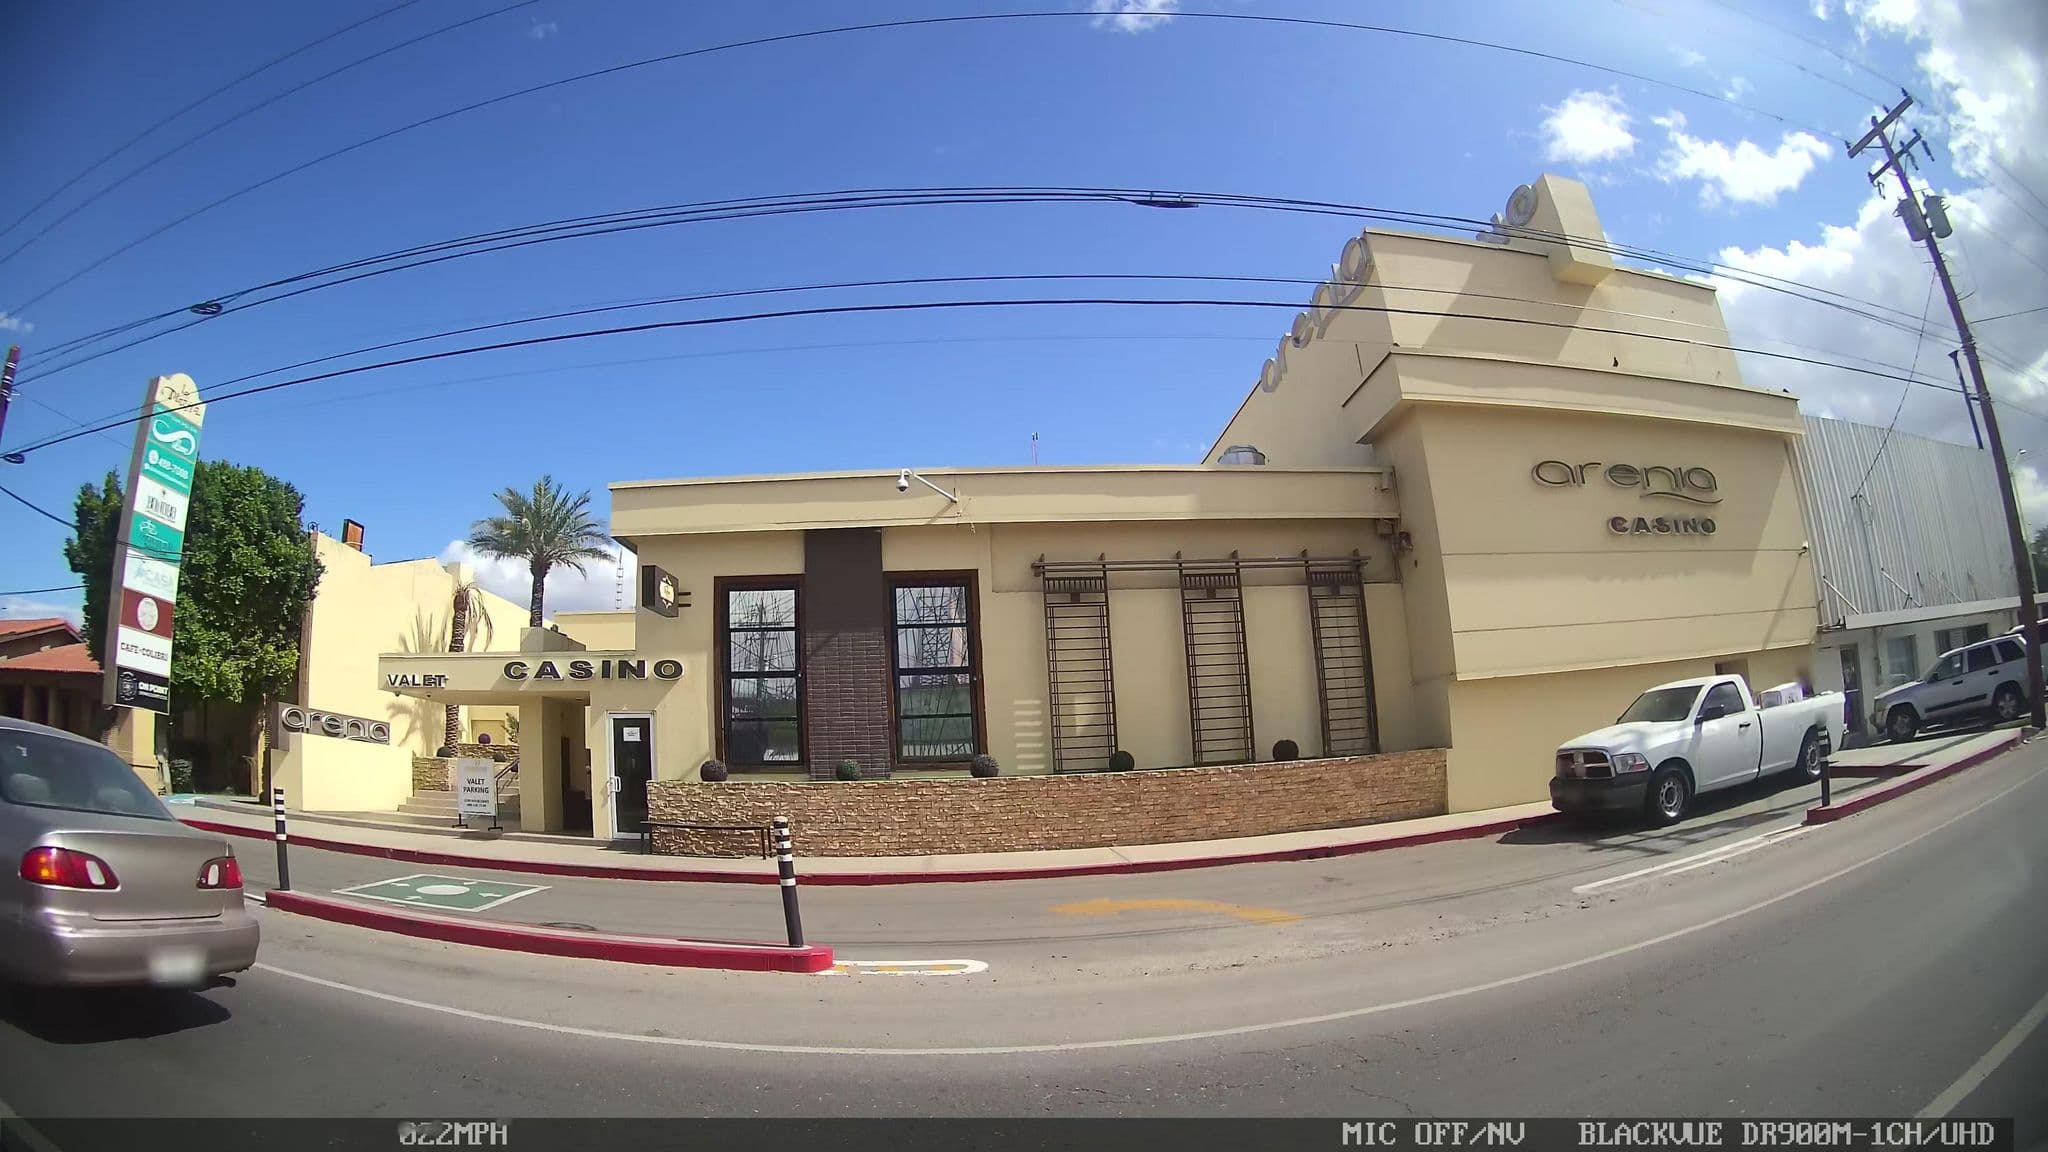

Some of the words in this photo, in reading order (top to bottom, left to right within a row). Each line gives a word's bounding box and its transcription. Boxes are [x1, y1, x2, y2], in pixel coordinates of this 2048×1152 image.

[1532, 461, 1718, 495] arena
[1609, 516, 1717, 535] CASINO
[386, 673, 449, 688] VALET
[503, 658, 685, 681] CASINO
[281, 706, 389, 745] arena
[463, 786, 489, 794] PARKING
